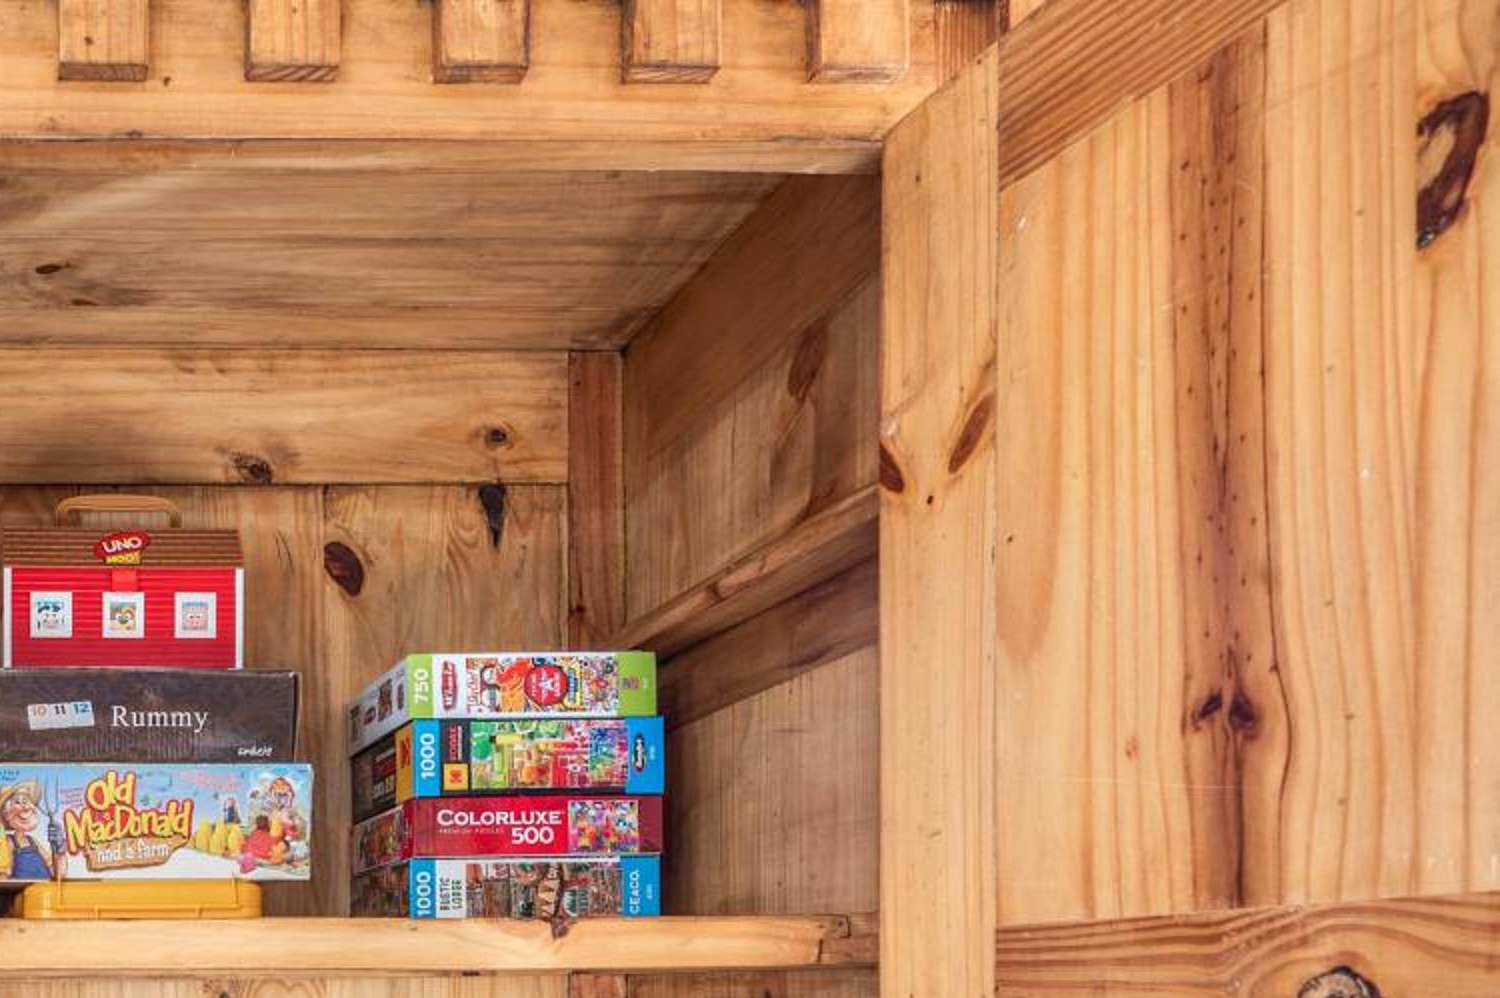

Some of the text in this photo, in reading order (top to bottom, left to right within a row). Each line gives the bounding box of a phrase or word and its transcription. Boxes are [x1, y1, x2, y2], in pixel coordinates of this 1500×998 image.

[102, 536, 143, 553] UNO
[414, 668, 429, 705] 750
[31, 703, 90, 717] 10 11 12
[111, 705, 208, 732] Rummy
[419, 733, 435, 780] 1000
[86, 770, 136, 810] Old
[64, 799, 195, 854] MacDonald
[437, 809, 562, 826] COLORLUXE
[512, 826, 555, 844] 500
[416, 871, 431, 916] 1000
